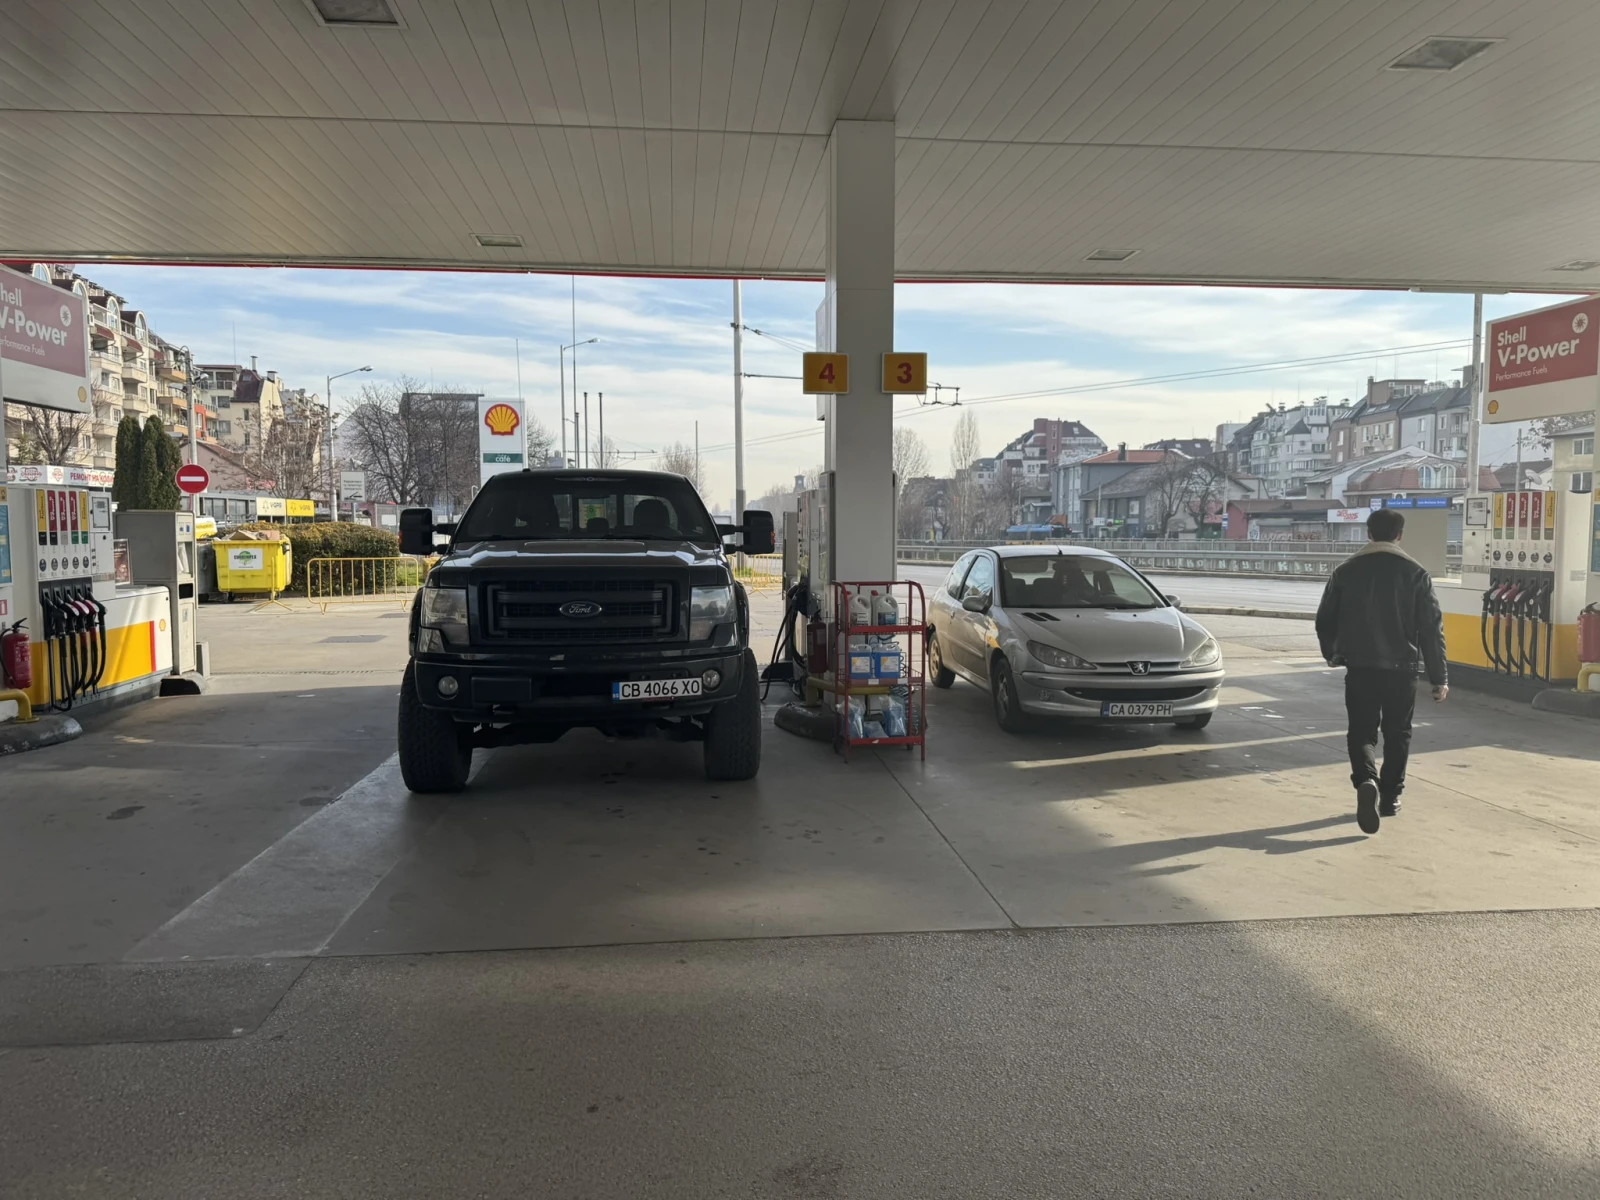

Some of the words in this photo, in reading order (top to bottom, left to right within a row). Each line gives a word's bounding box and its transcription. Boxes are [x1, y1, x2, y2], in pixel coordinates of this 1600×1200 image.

[0, 282, 22, 307] hell
[0, 335, 30, 353] erformance
[32, 344, 45, 356] Fuels
[1497, 326, 1527, 346] Shell
[1497, 338, 1580, 367] V-Power
[818, 362, 836, 384] 4
[896, 362, 913, 384] 3
[1496, 368, 1532, 381] Performance
[1532, 364, 1548, 375] Fuels
[70, 472, 91, 482] РЕМОНТ
[569, 603, 592, 613] Ford
[621, 683, 641, 697] CB
[644, 681, 679, 696] 4066
[682, 680, 699, 694] XO
[1110, 704, 1125, 715] CA
[1127, 704, 1155, 715] 0379
[1156, 704, 1171, 715] PH
